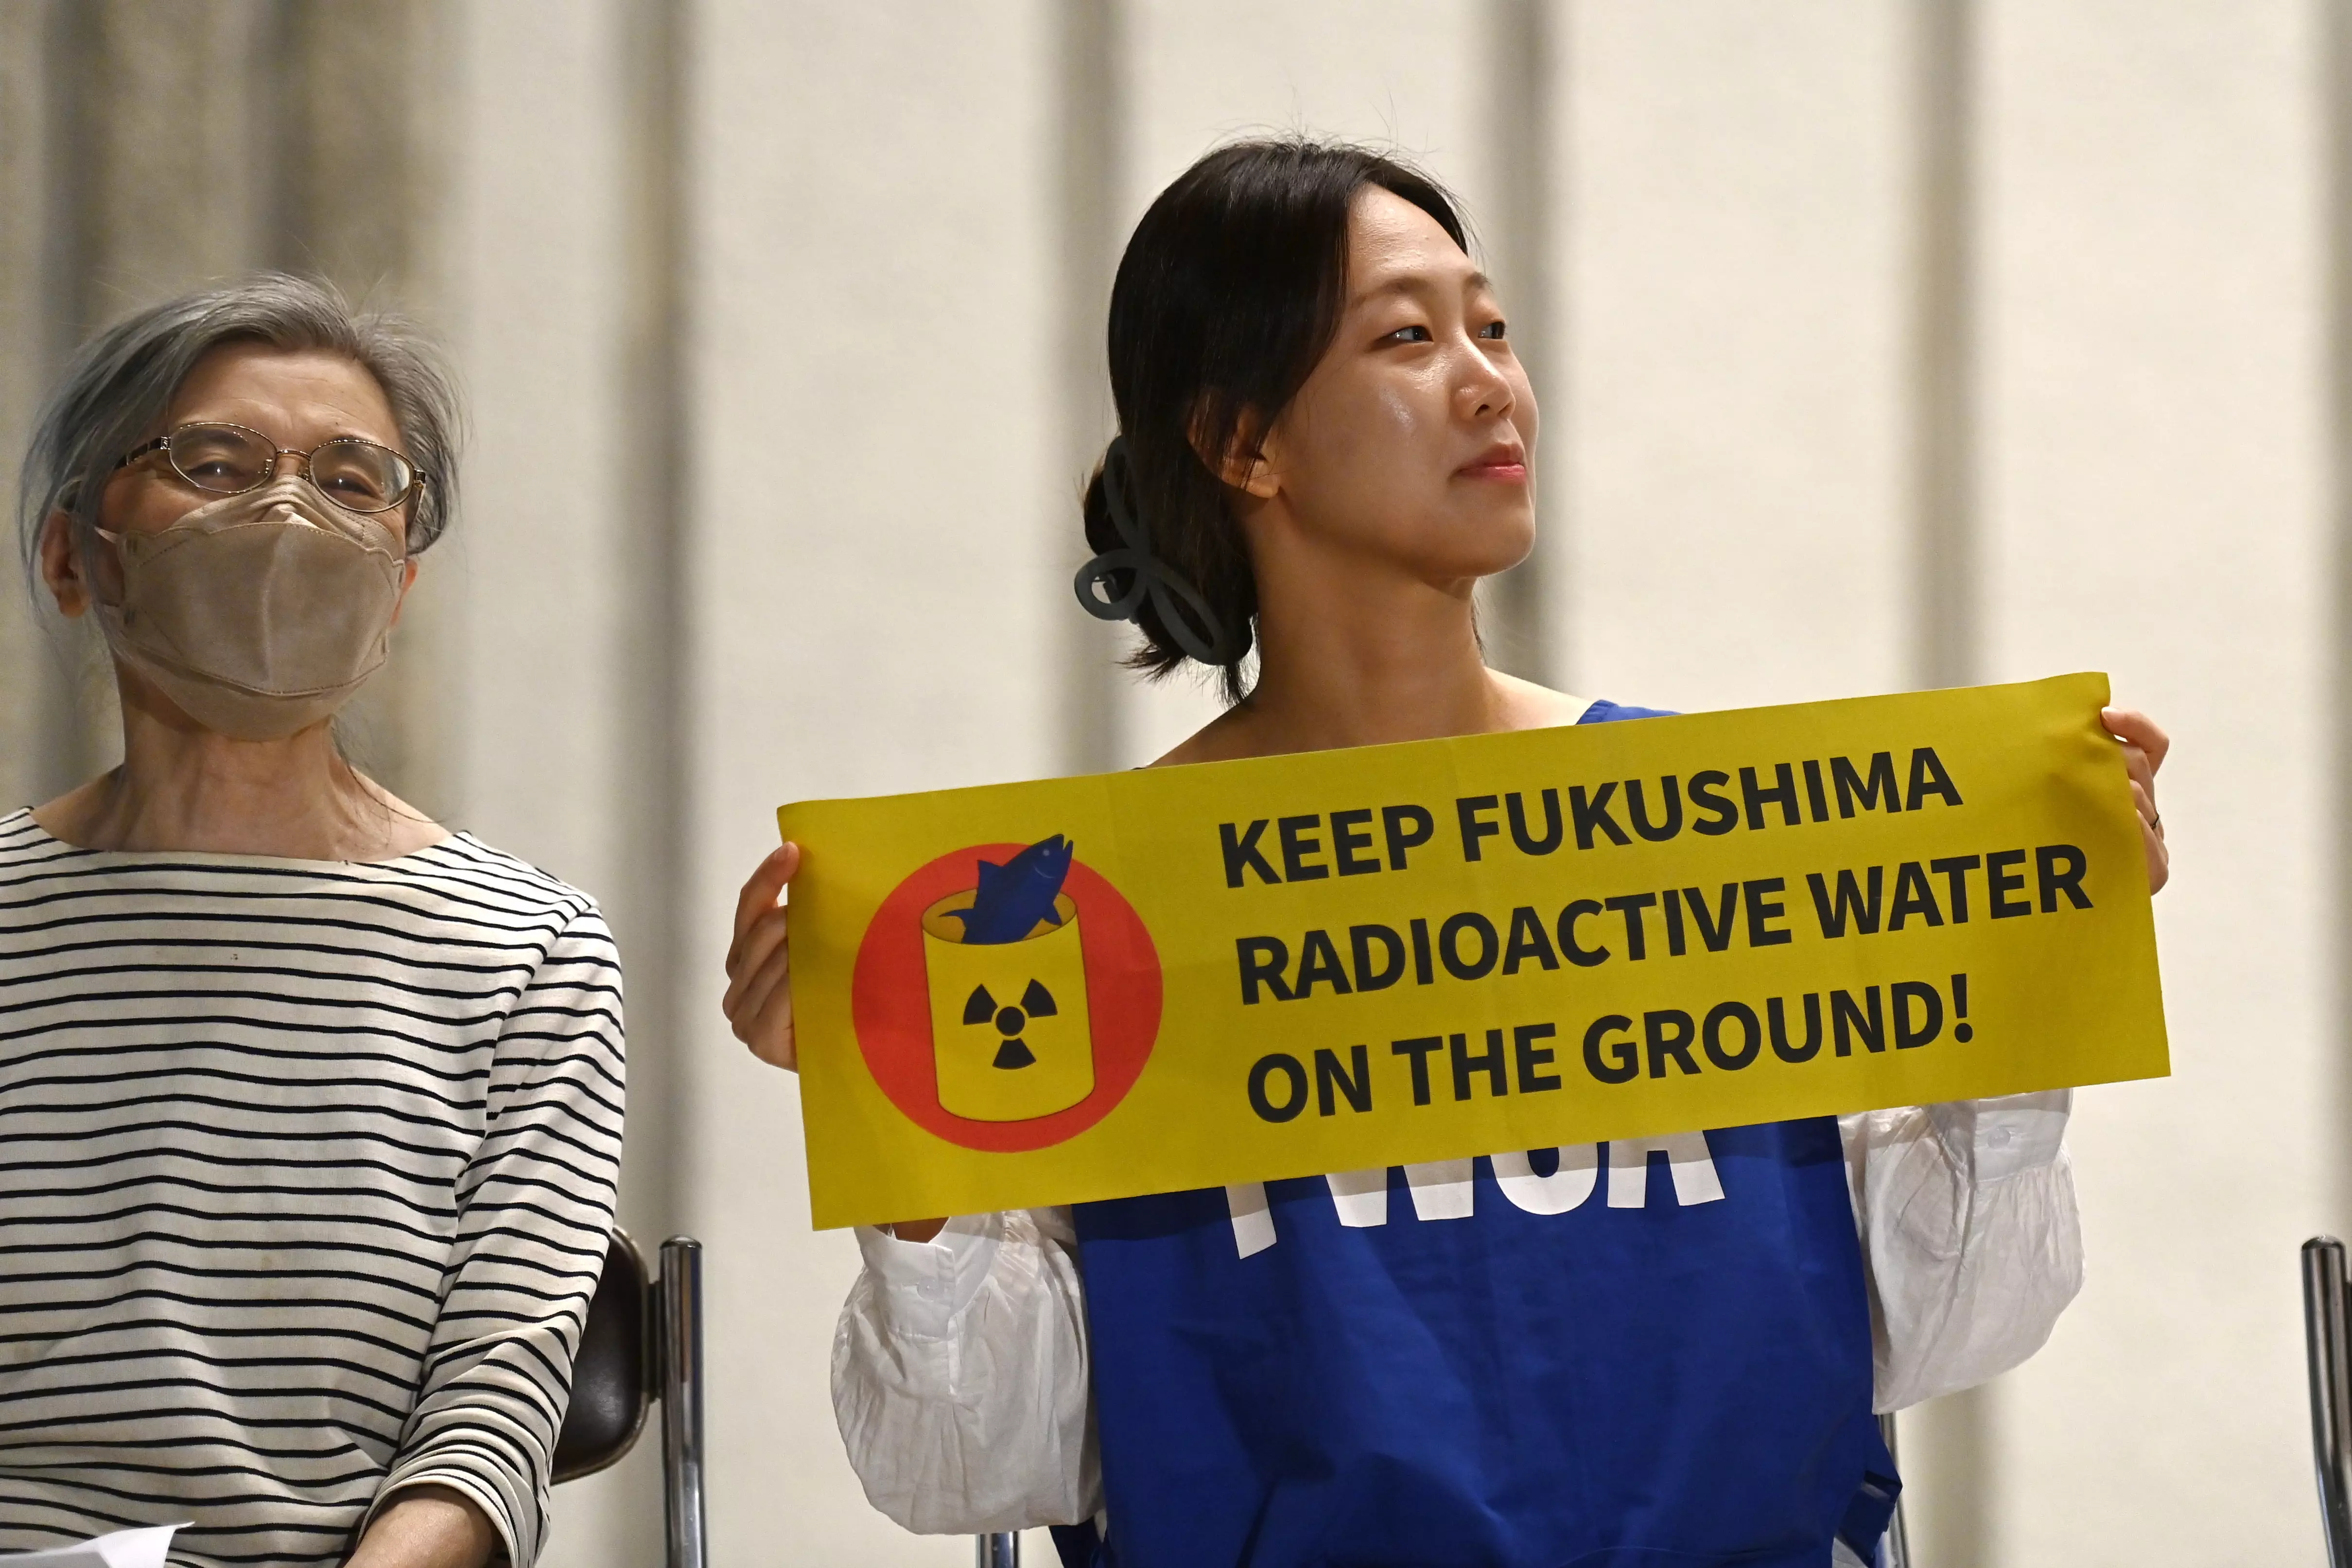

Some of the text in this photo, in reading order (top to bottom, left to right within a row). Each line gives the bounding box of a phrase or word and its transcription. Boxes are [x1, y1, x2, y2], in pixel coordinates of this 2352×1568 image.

[1218, 747, 1964, 889] KEEP FUKUSHIMA
[1235, 844, 2094, 1006] RADIOACTIVE WATER
[1247, 973, 1973, 1124] ON THE GROUND!
